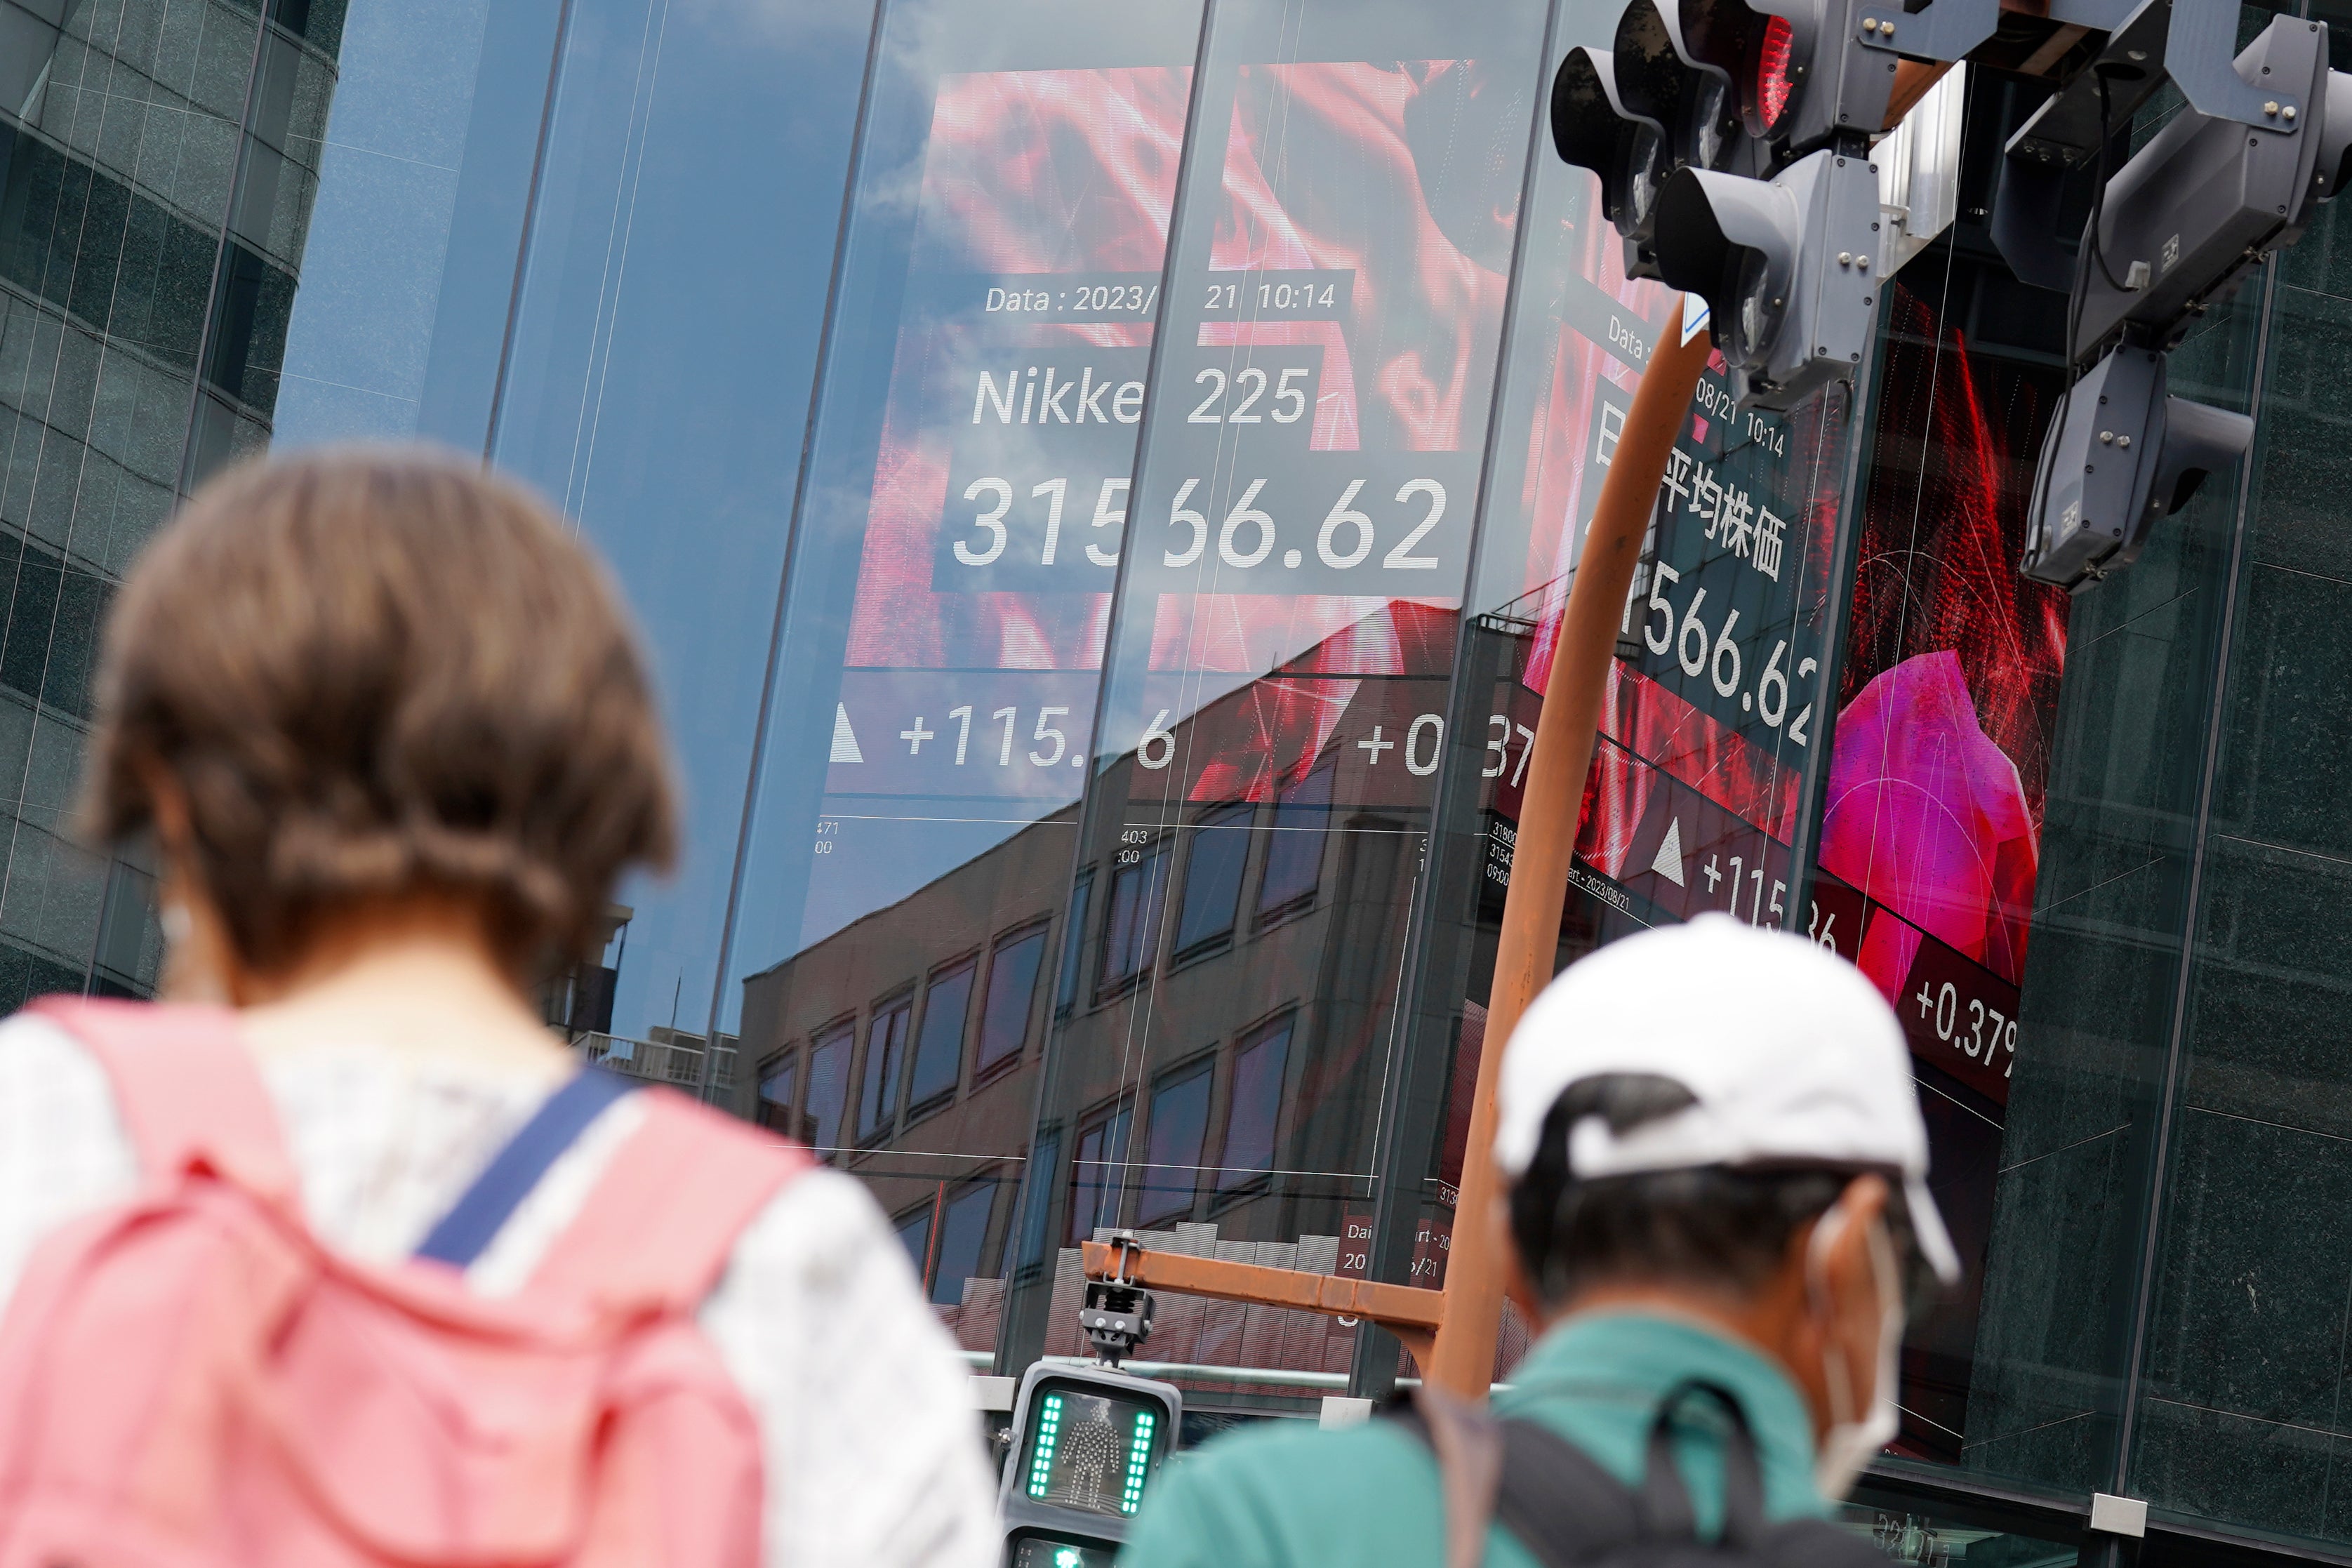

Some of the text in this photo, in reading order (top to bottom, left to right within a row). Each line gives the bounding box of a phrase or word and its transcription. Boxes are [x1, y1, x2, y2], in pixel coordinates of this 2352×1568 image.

[985, 287, 1050, 312] Data
[1258, 284, 1335, 310] 10:14
[972, 366, 1310, 424] Nikke 225
[1609, 314, 1642, 361] Data
[1696, 378, 1736, 425] 08/21
[1747, 412, 1784, 458] 10:14
[1595, 400, 1786, 583] 日平均株価
[1585, 519, 1817, 747] 1566.62
[900, 705, 1176, 770] +115.6
[1487, 863, 1510, 886] 09:00
[1586, 875, 1630, 910] 2023/08/21
[1348, 1224, 1373, 1240] Dai
